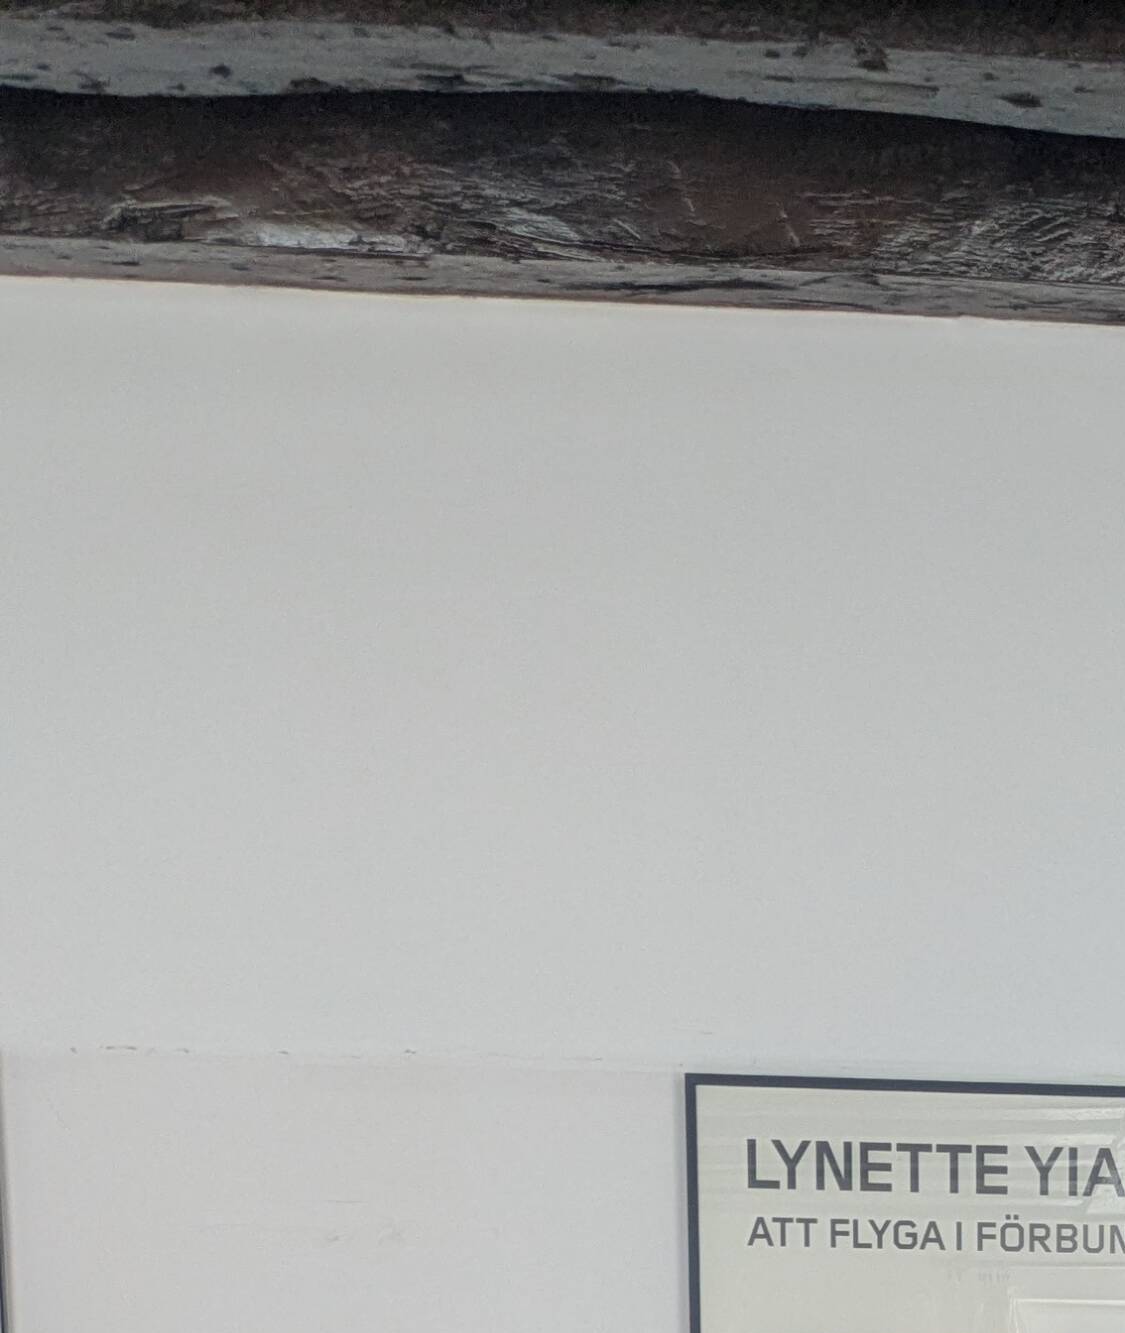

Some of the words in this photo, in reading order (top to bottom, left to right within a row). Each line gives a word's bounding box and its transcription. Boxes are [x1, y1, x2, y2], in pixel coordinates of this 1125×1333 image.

[747, 1138, 1009, 1197] LYNETTE
[747, 1217, 819, 1249] ATT
[829, 1219, 946, 1252] FLYGA
[955, 1221, 964, 1252] I
